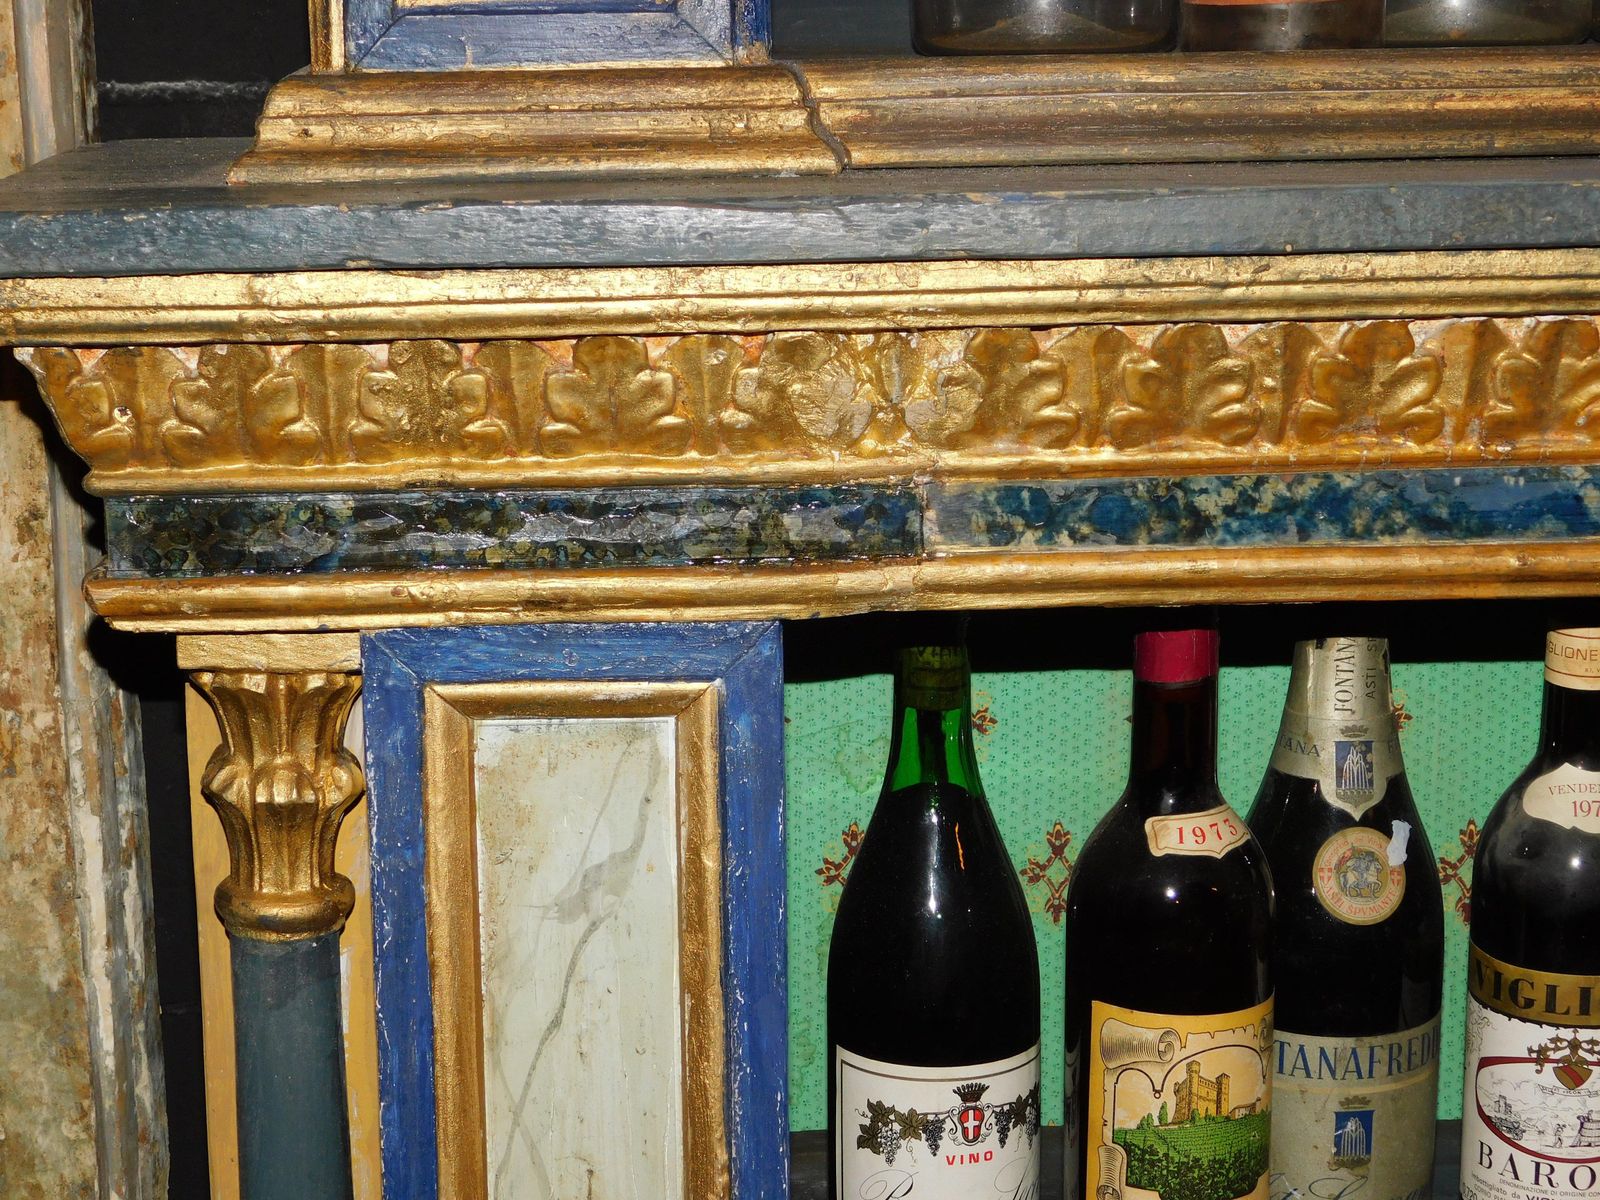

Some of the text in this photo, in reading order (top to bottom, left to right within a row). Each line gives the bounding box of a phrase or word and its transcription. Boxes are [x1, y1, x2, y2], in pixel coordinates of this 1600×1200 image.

[1365, 668, 1377, 699] ASTI
[1475, 958, 1594, 1016] VIGLI
[945, 1150, 993, 1166] VINO
[1478, 1140, 1597, 1191] BARO
[1499, 1178, 1548, 1195] DENOMINAZIONE
[1559, 1190, 1586, 1198] ORIGINE
